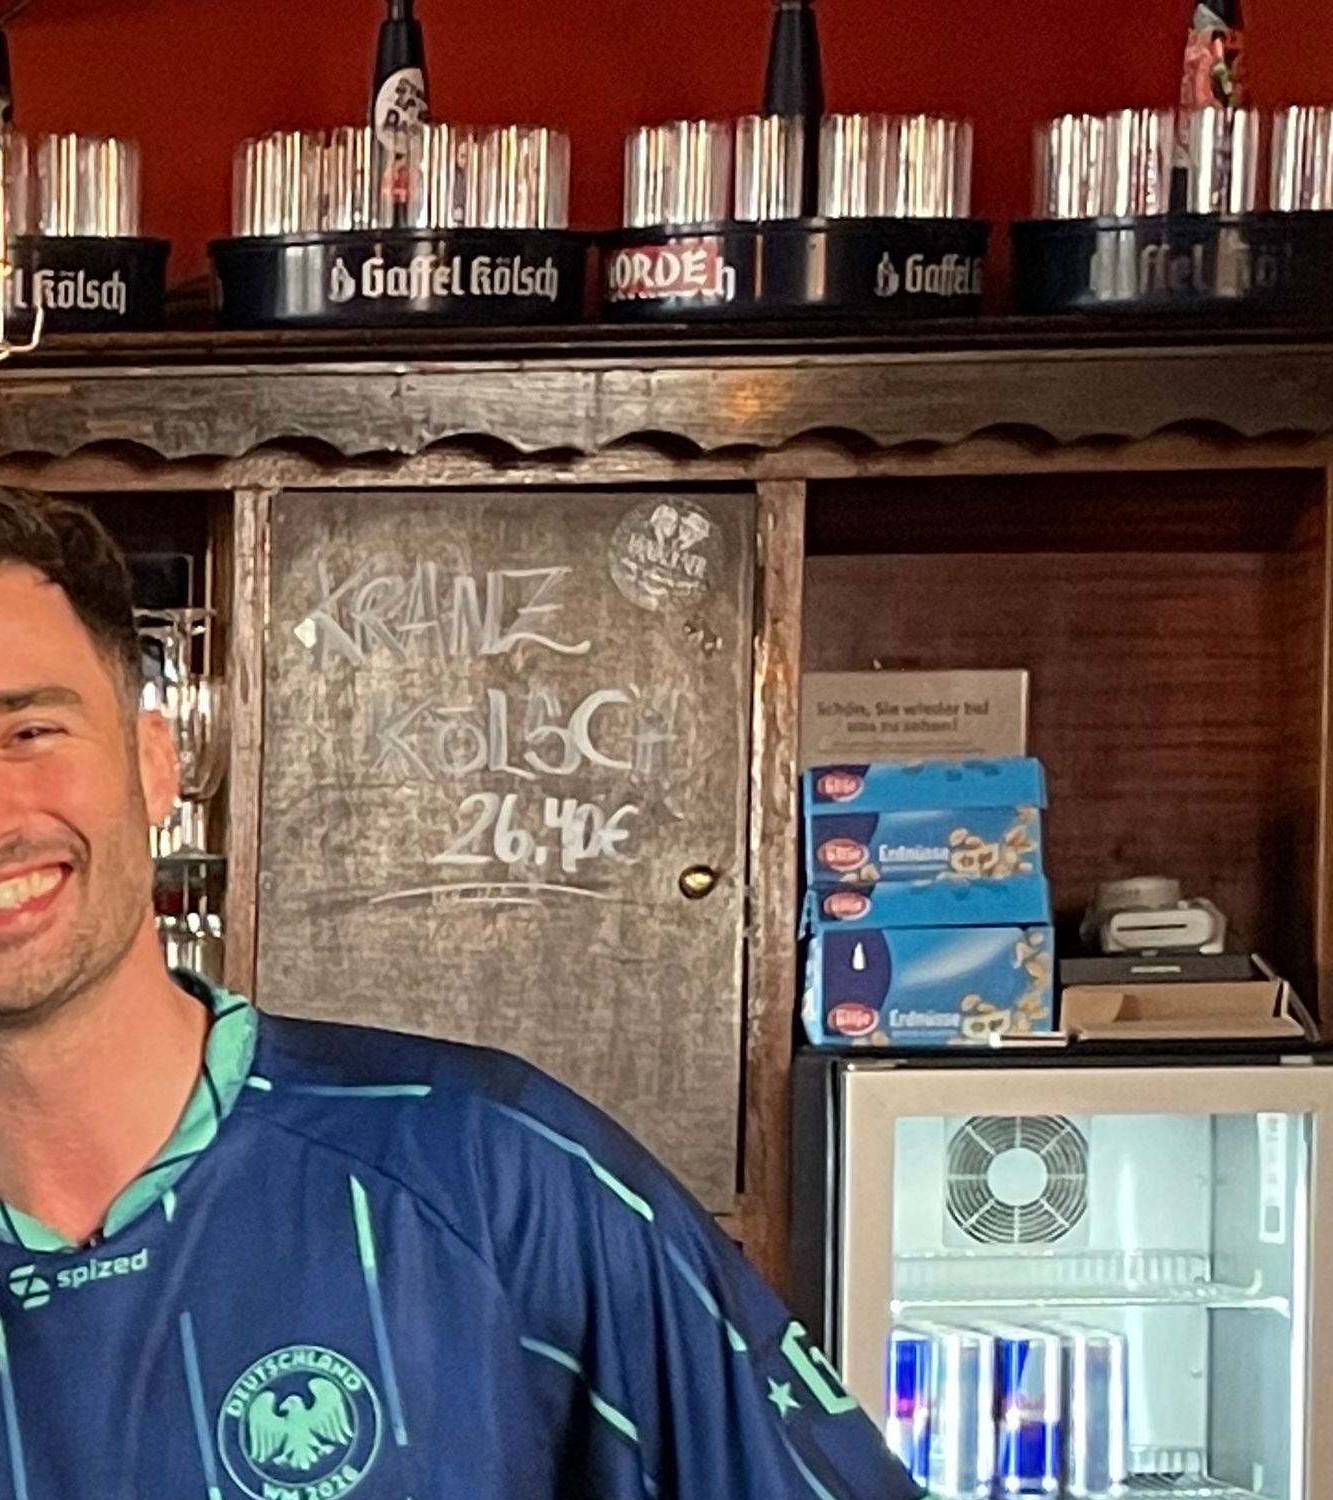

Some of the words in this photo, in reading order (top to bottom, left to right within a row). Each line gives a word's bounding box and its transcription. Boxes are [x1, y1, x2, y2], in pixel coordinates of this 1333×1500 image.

[360, 255, 465, 301] Gaffel
[470, 255, 559, 302] Kölsch
[609, 248, 710, 291] ORDE
[34, 269, 128, 315] Kölsch
[309, 556, 592, 668] KRANZ
[878, 843, 950, 863] Erdnüsse
[889, 1008, 961, 1028] Erdnüsse
[55, 1247, 149, 1289] spized
[226, 1351, 363, 1418] DEUTSCHLAND
